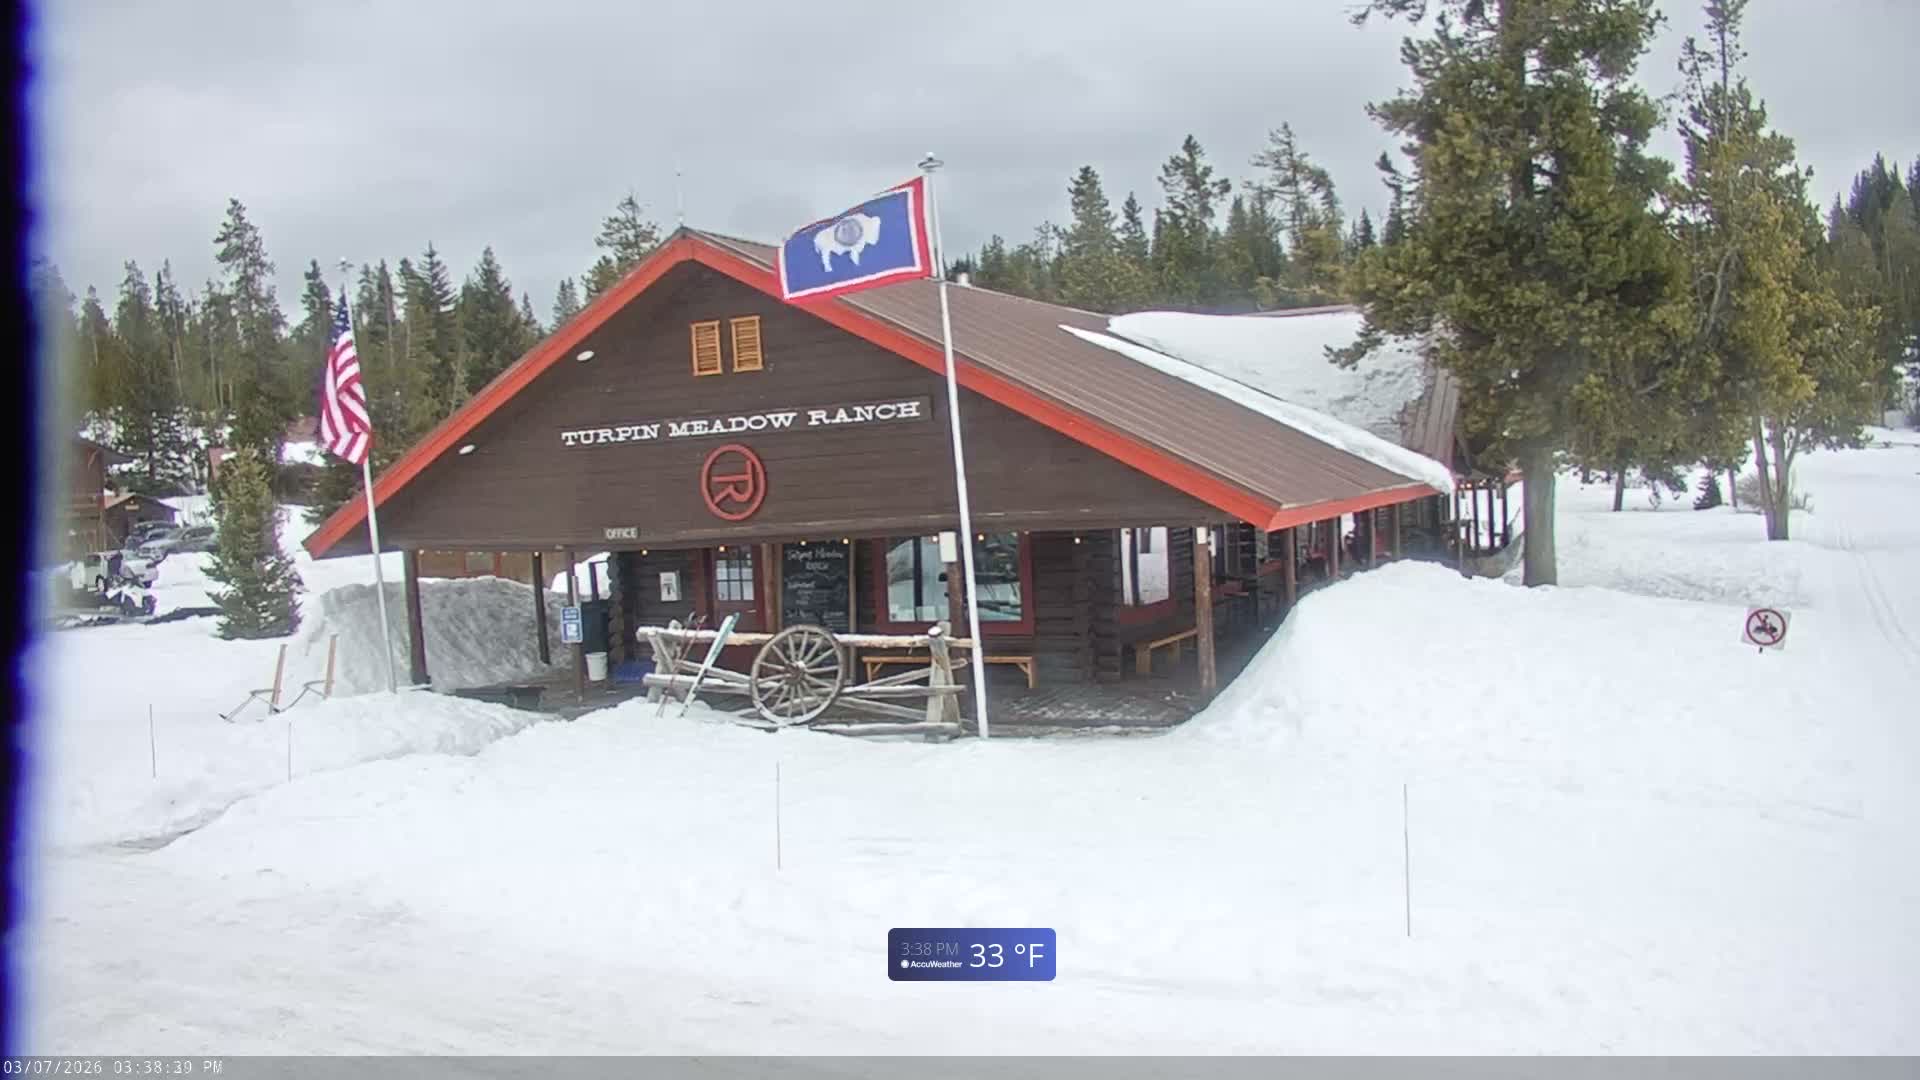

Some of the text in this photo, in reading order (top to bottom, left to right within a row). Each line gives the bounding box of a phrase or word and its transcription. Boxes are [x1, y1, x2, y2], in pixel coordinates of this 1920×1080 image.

[561, 401, 921, 446] TURPIN MEADOW RANCH
[606, 527, 638, 539] OFFICE
